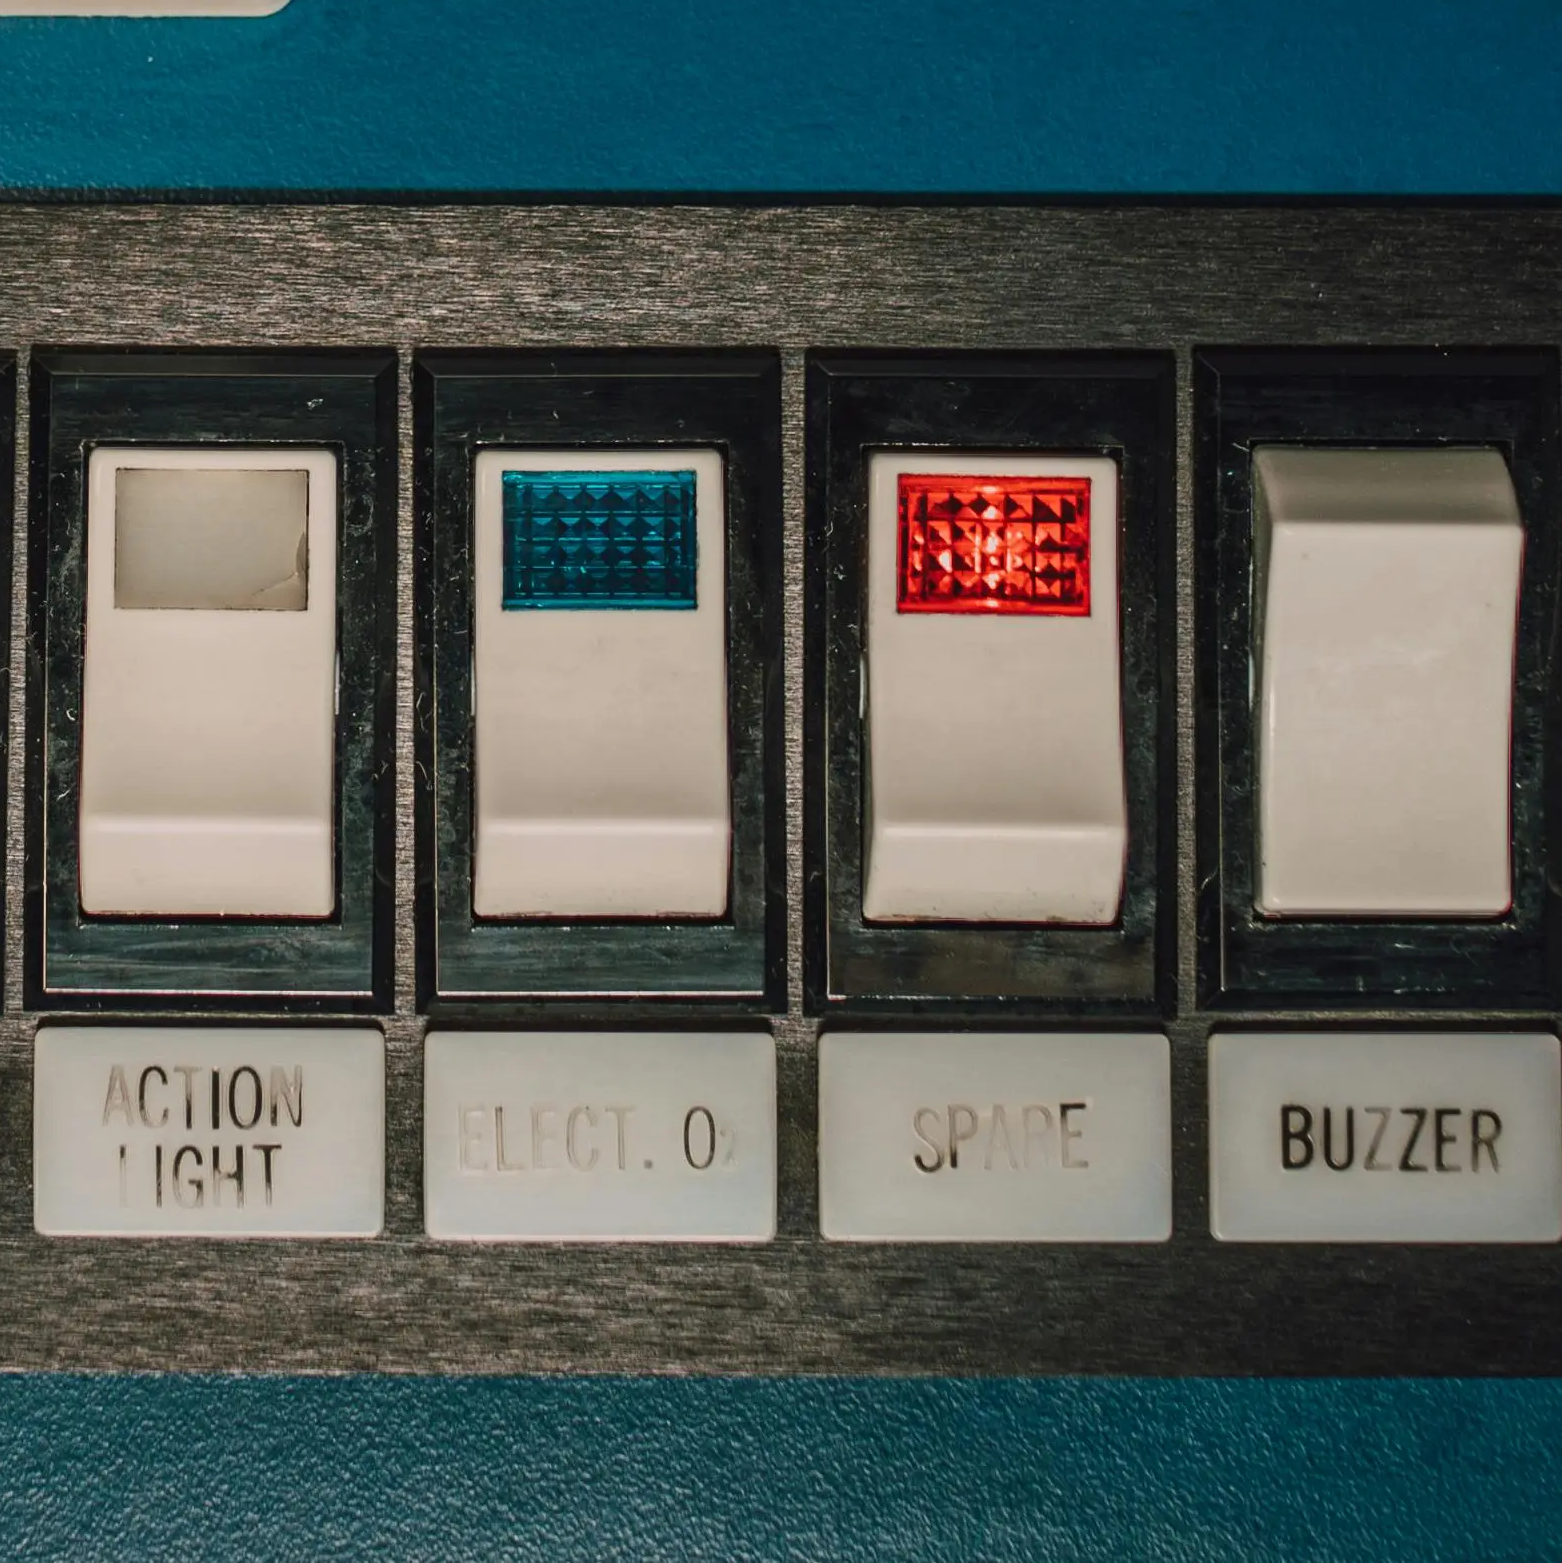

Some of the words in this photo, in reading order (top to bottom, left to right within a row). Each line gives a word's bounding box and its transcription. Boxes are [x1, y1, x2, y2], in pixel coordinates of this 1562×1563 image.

[101, 1065, 303, 1130] ACTION
[458, 1105, 653, 1172] ELECT.
[912, 1102, 1090, 1173] SPARE
[1280, 1104, 1503, 1173] BUZZER
